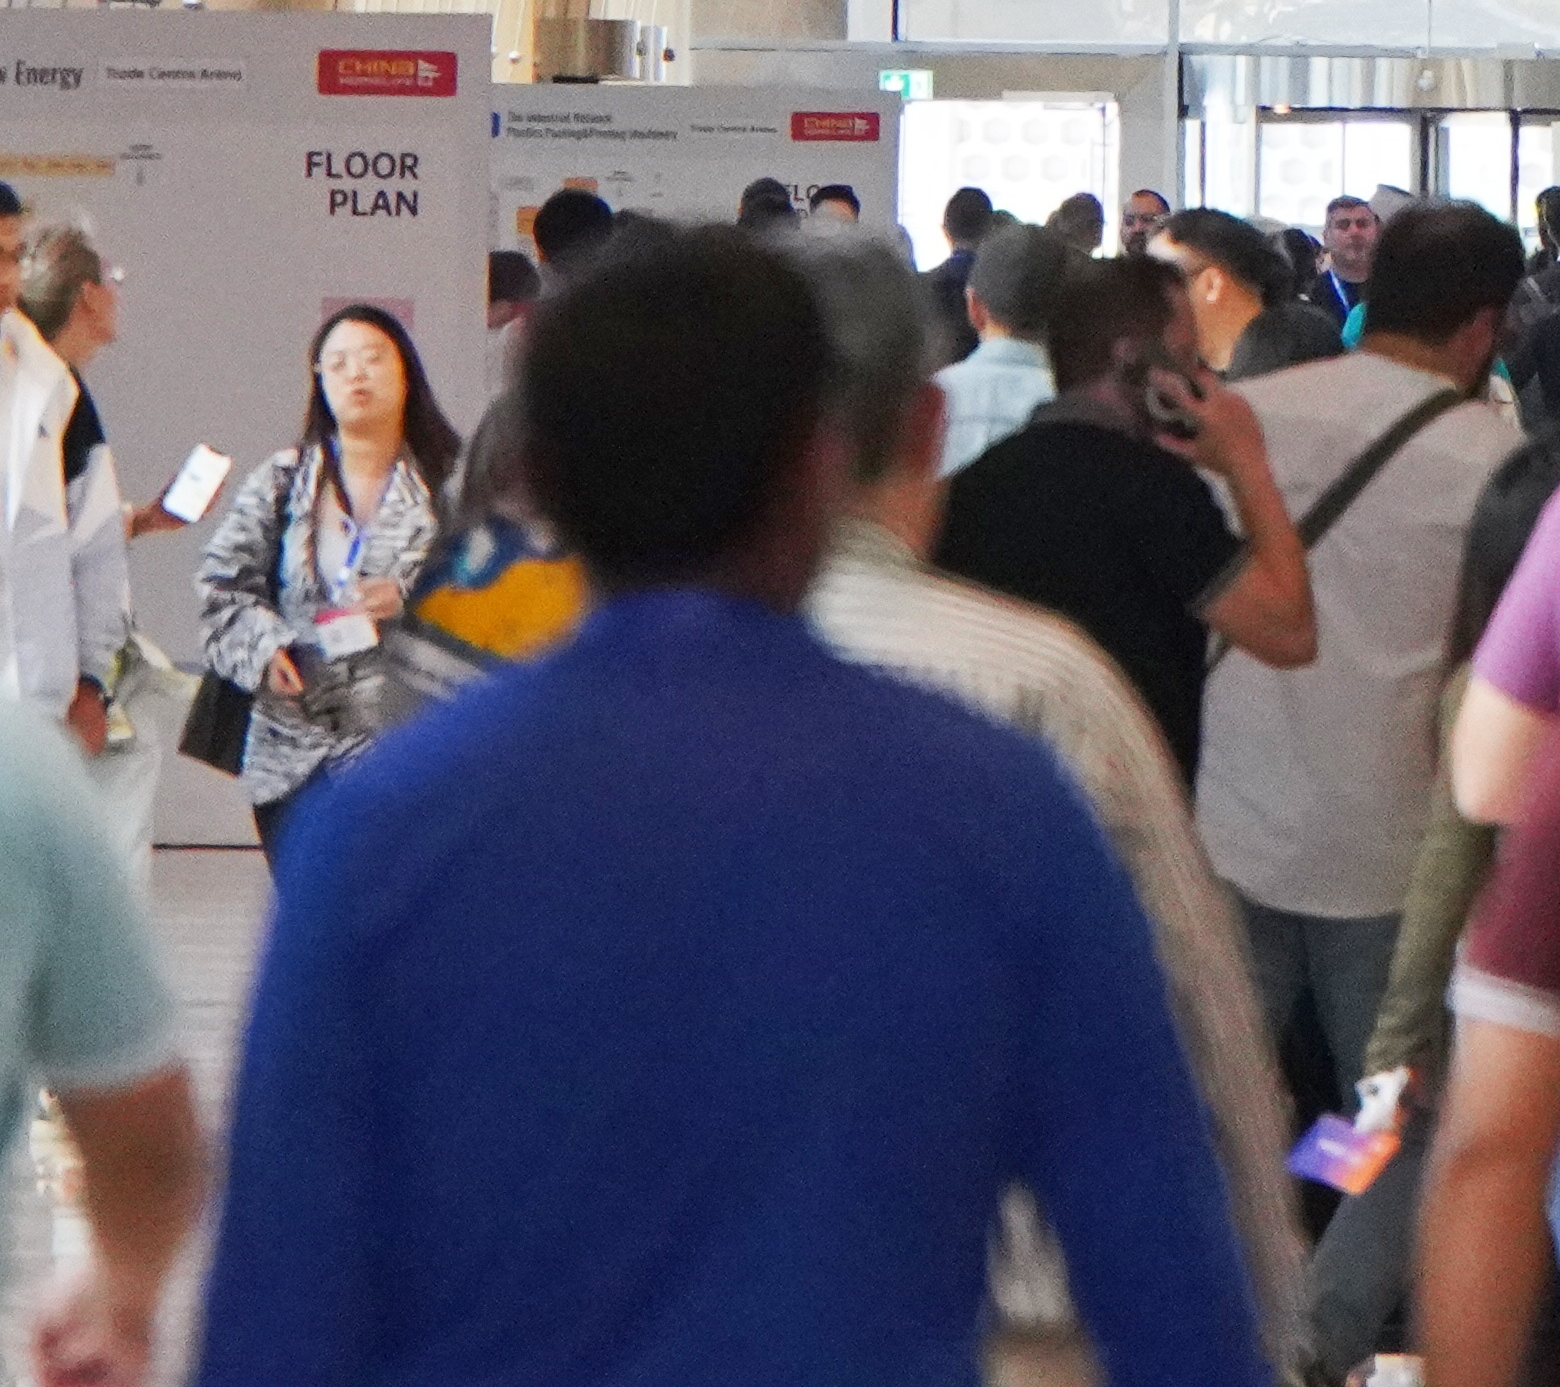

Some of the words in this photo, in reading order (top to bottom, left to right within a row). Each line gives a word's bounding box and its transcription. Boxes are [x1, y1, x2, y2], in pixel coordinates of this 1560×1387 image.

[14, 60, 84, 90] Energy
[305, 150, 419, 179] FLOOR
[329, 188, 419, 217] PLAN
